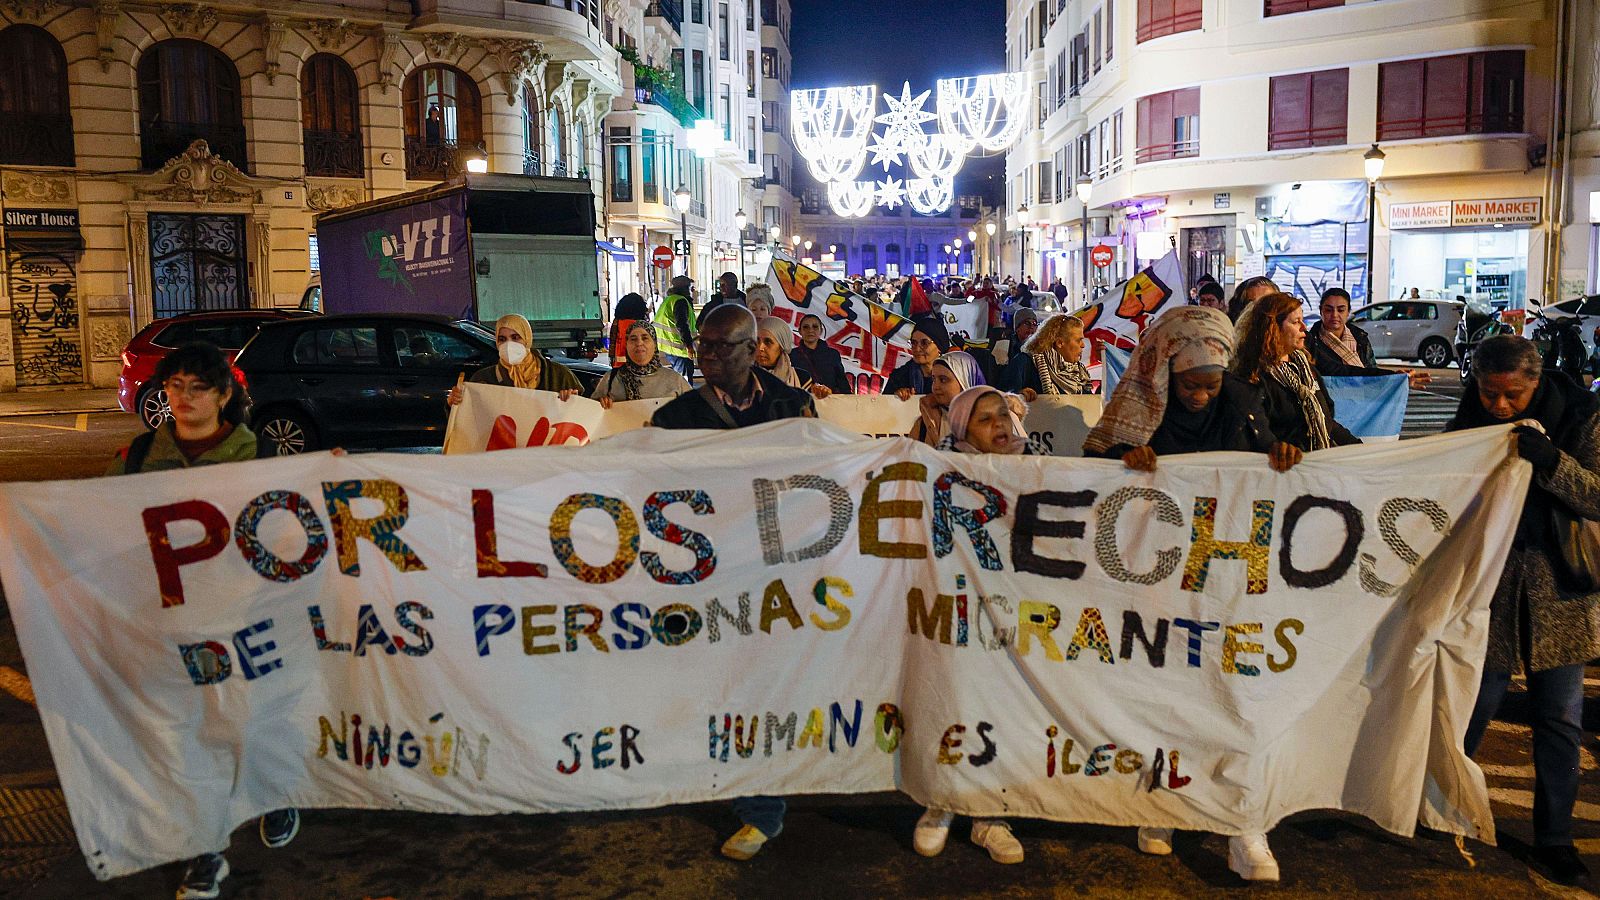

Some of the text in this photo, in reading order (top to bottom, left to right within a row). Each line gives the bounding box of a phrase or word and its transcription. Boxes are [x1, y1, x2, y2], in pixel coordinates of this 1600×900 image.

[6, 211, 76, 226] Silver House
[1392, 205, 1450, 218] MINI MARKET
[1455, 201, 1538, 215] MINI MARKET
[402, 215, 451, 261] VTI
[141, 461, 1451, 608] POR LOS DERECHOS
[178, 618, 284, 686] DE
[308, 601, 434, 658] LAS
[472, 576, 854, 657] PERSONAS
[556, 723, 645, 775] SER
[708, 699, 904, 763] HUMANO
[936, 721, 998, 767] ES
